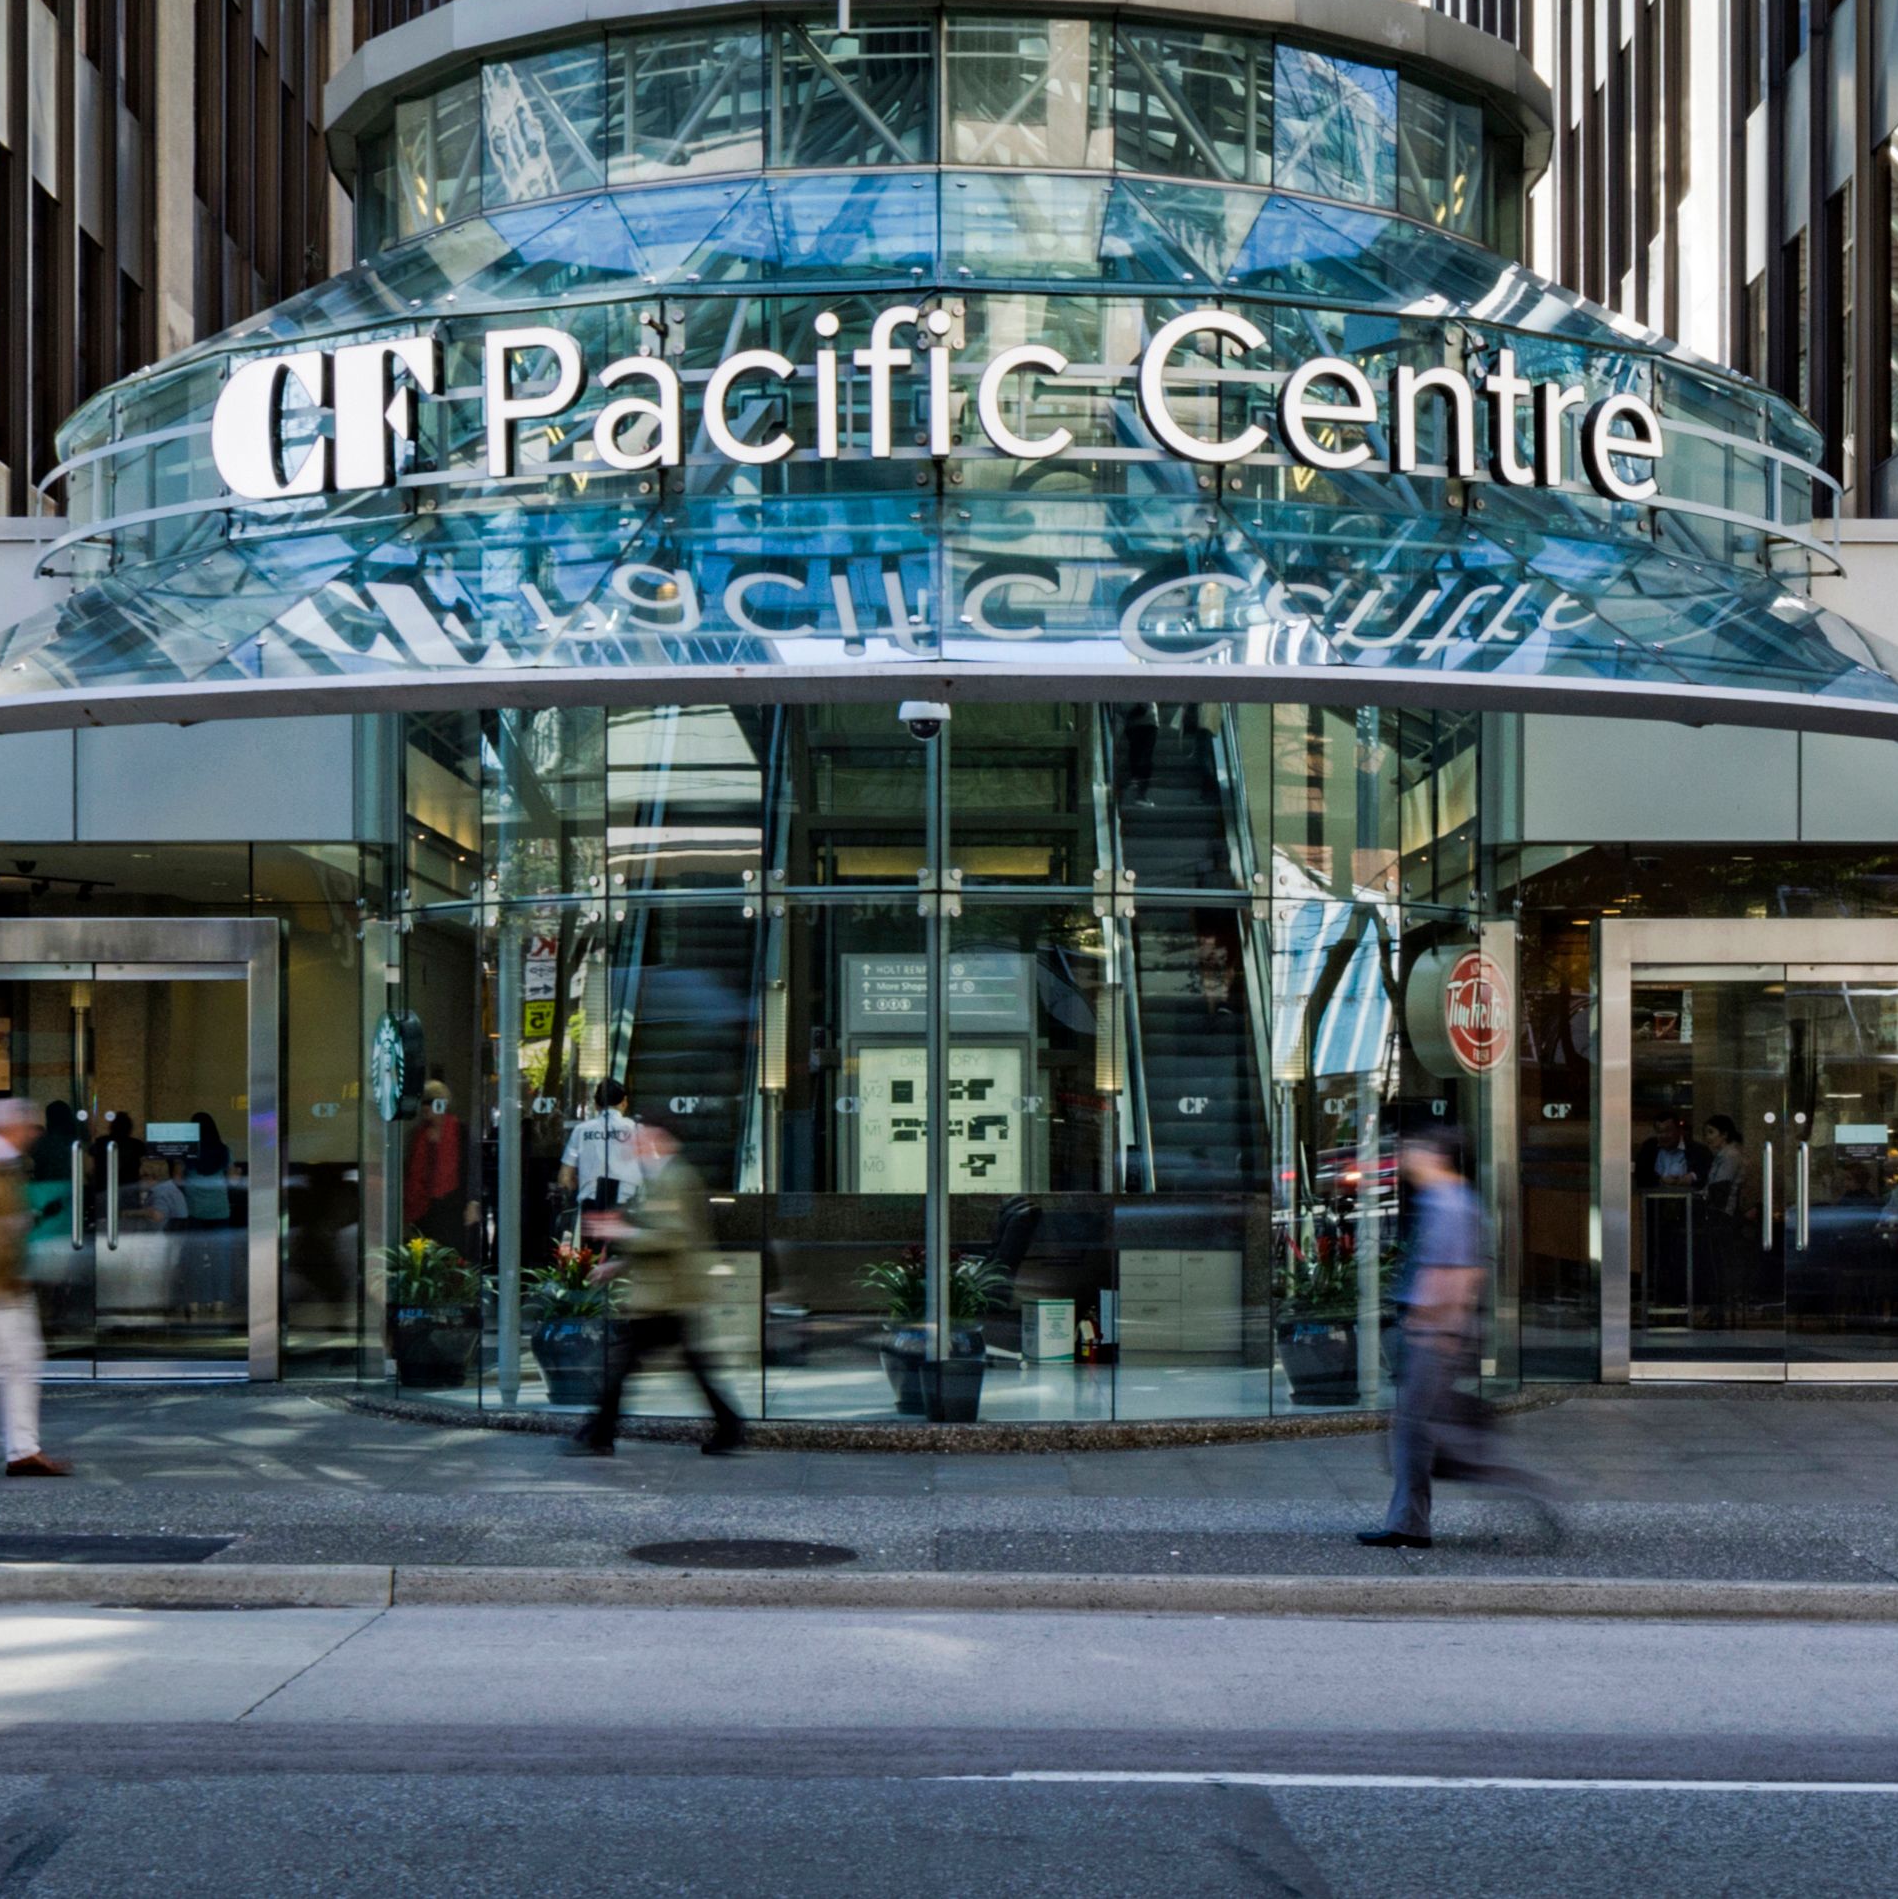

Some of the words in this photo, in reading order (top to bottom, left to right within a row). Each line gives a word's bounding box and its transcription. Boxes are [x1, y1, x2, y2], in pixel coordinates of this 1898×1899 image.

[210, 335, 438, 500] CF
[486, 304, 1073, 478] Pacific
[1137, 309, 1664, 502] Centre
[533, 1097, 557, 1113] CF
[670, 1097, 698, 1113] CF
[1178, 1097, 1208, 1114] CF
[1324, 1098, 1347, 1114] CF
[1543, 1103, 1572, 1118] CF
